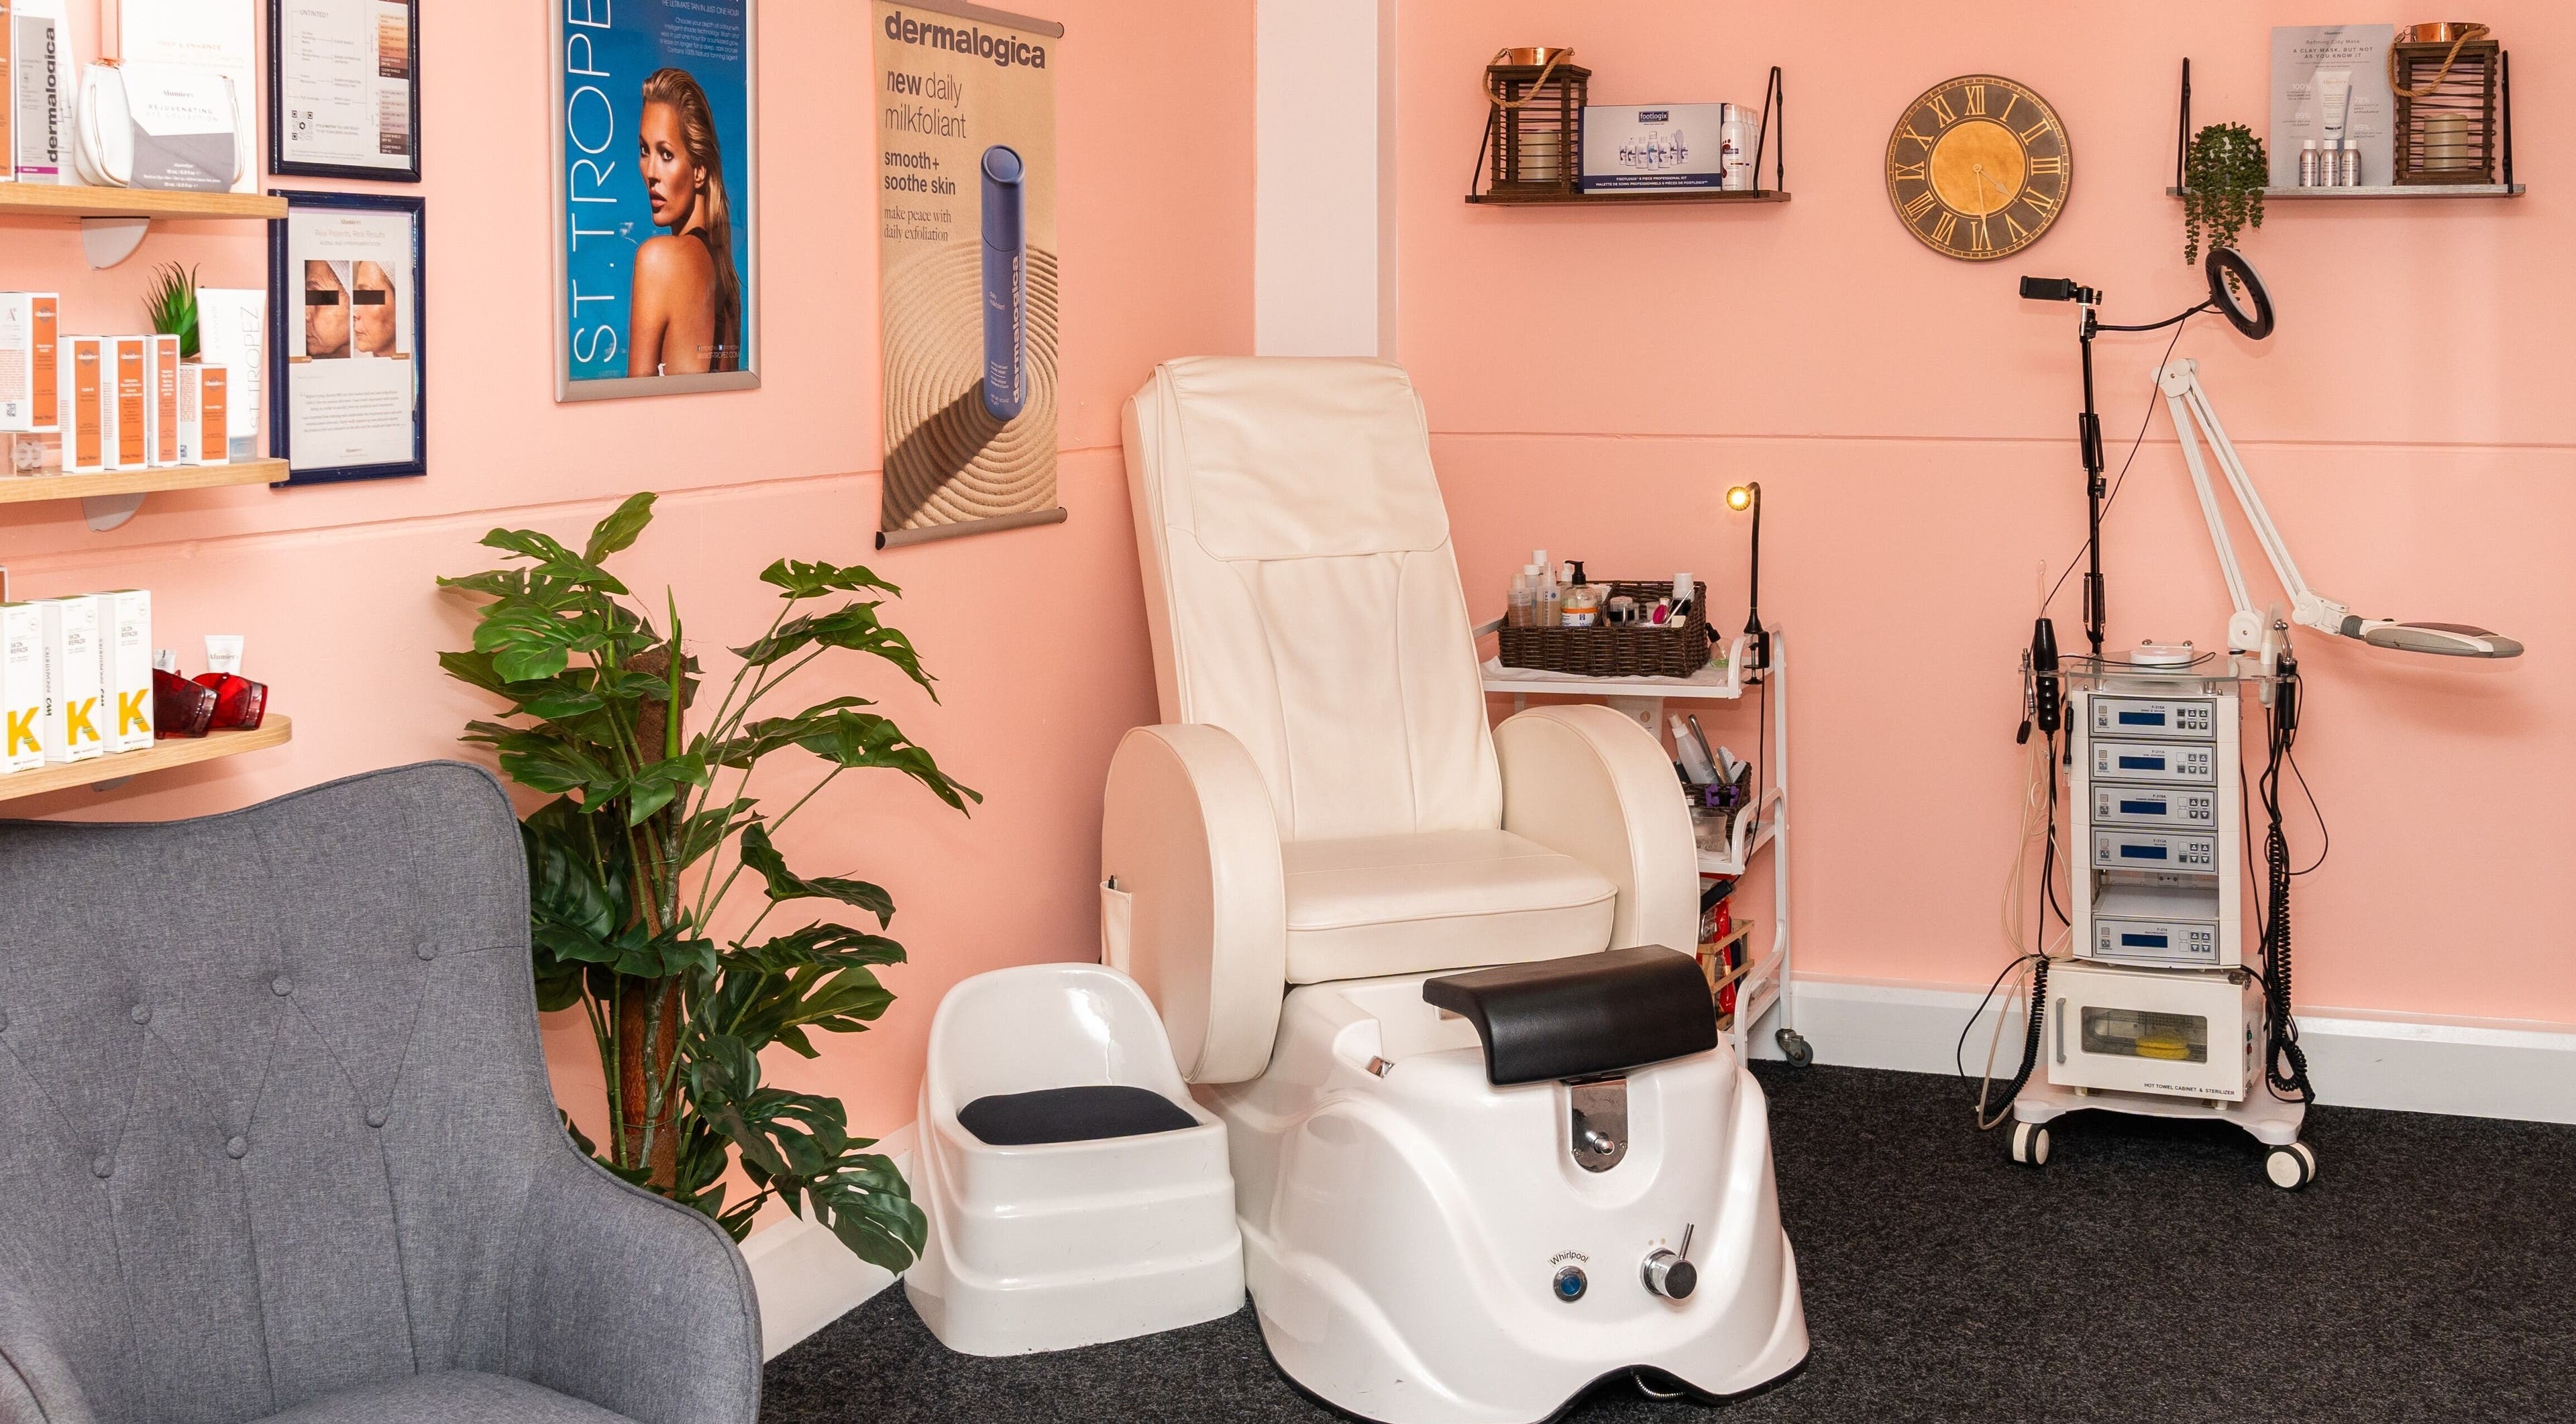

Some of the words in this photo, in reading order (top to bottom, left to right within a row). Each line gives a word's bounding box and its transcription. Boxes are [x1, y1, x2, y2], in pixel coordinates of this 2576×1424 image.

[885, 11, 1046, 69] dermalogica
[46, 28, 58, 163] dermalogica
[887, 70, 922, 96] new
[925, 72, 963, 109] daily
[1964, 85, 1986, 116] XII
[148, 104, 213, 114] REJUVENATING
[885, 103, 967, 139] milkfoliant
[1640, 112, 1667, 121] footlogix
[1927, 94, 1957, 129] XI
[1999, 93, 2020, 122] I
[1901, 125, 1934, 152] X
[2019, 117, 2053, 146] II
[1895, 160, 1925, 181] IX
[2030, 155, 2061, 176] III
[884, 174, 928, 193] soothe
[931, 176, 956, 195] skin
[884, 205, 906, 222] make
[907, 209, 932, 225] peace
[933, 208, 952, 223] with
[1904, 190, 1937, 223] VIII
[2021, 186, 2055, 218] IV
[884, 223, 904, 243] daily
[904, 226, 949, 242] exfoliation
[1931, 211, 1958, 245] VII
[2004, 212, 2029, 243] V
[1012, 256, 1020, 404] dermalogica
[66, 697, 101, 746] K
[118, 689, 152, 736] K
[7, 706, 42, 757] K
[1550, 1251, 1589, 1265] Whirlpool
